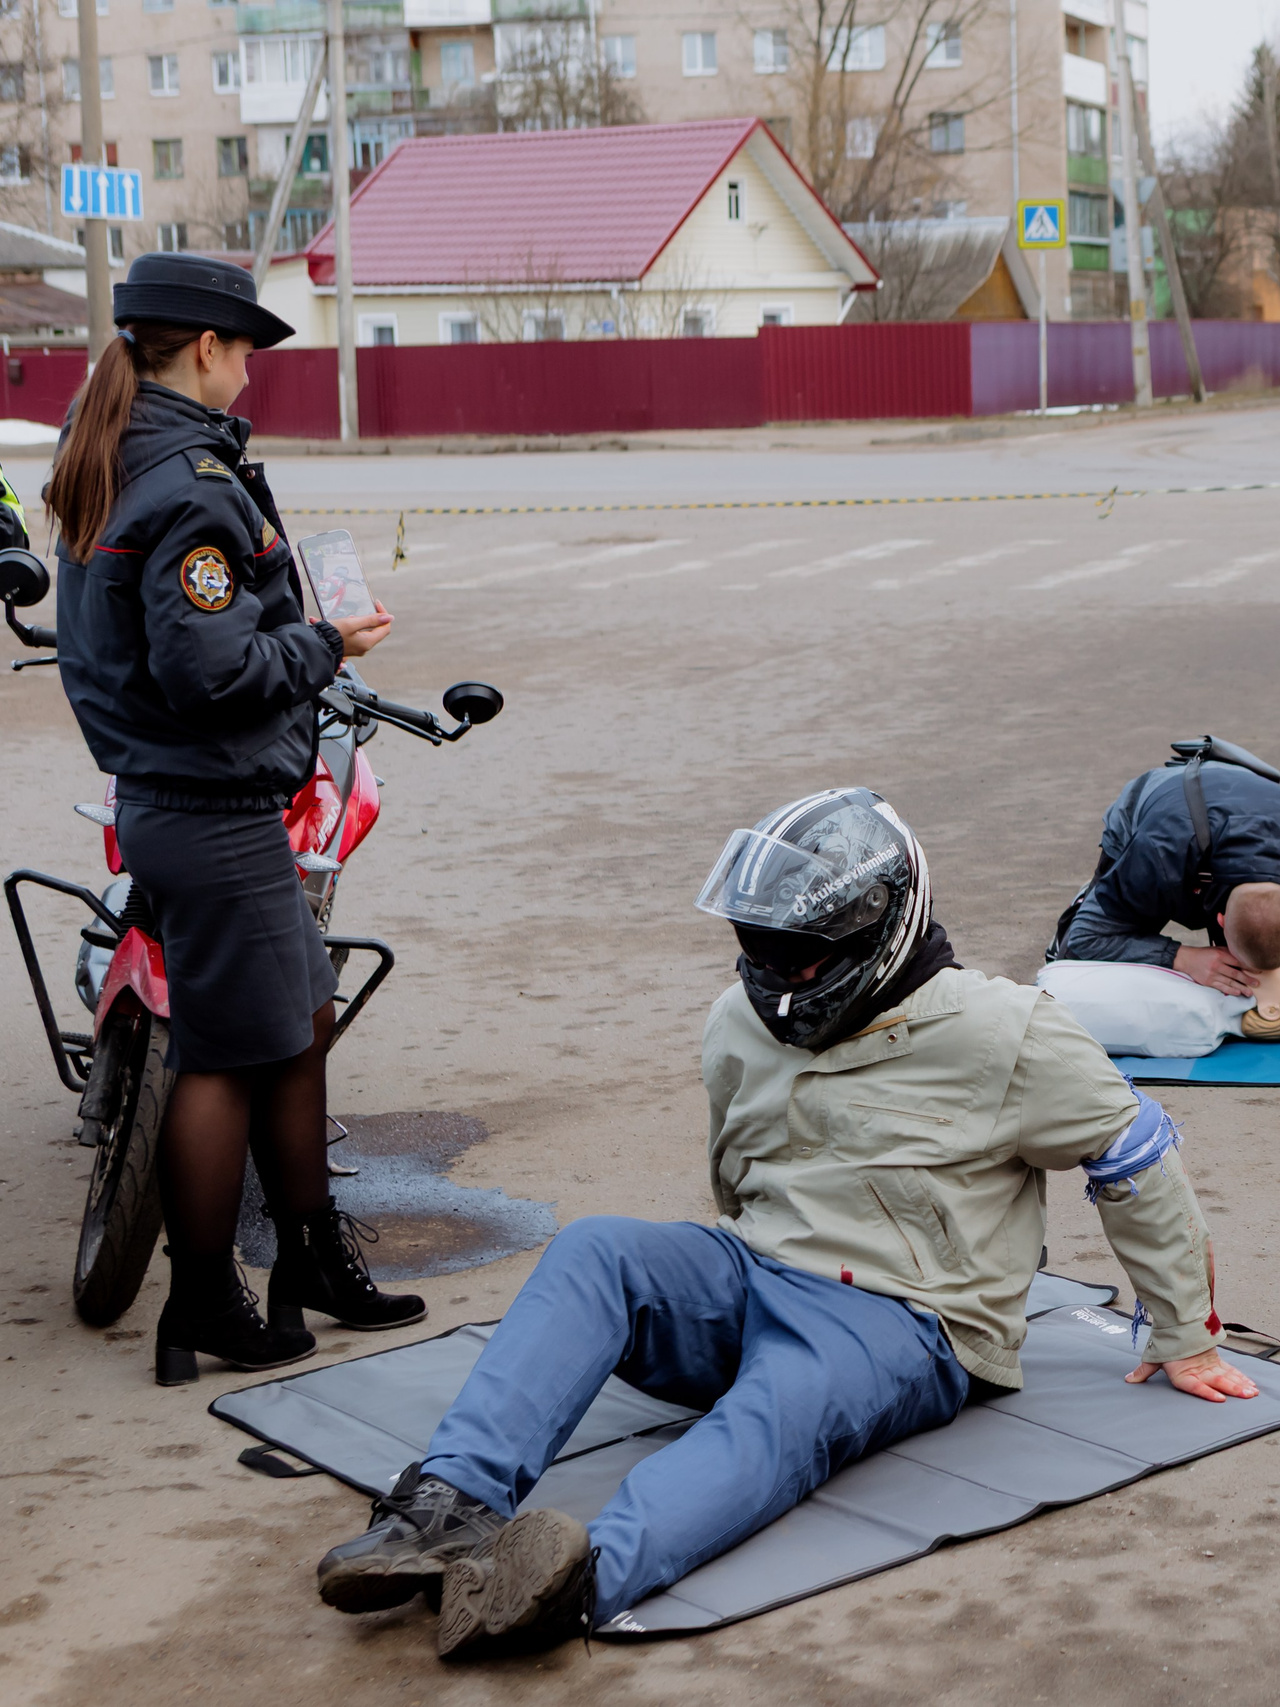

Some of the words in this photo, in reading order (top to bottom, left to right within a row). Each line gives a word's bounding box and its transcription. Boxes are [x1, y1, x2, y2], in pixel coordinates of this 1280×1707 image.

[309, 797, 342, 854] LIFAN
[807, 842, 900, 904] kuksevihmihail
[724, 896, 774, 917] LS2
[1071, 1310, 1110, 1329] Laerdal
